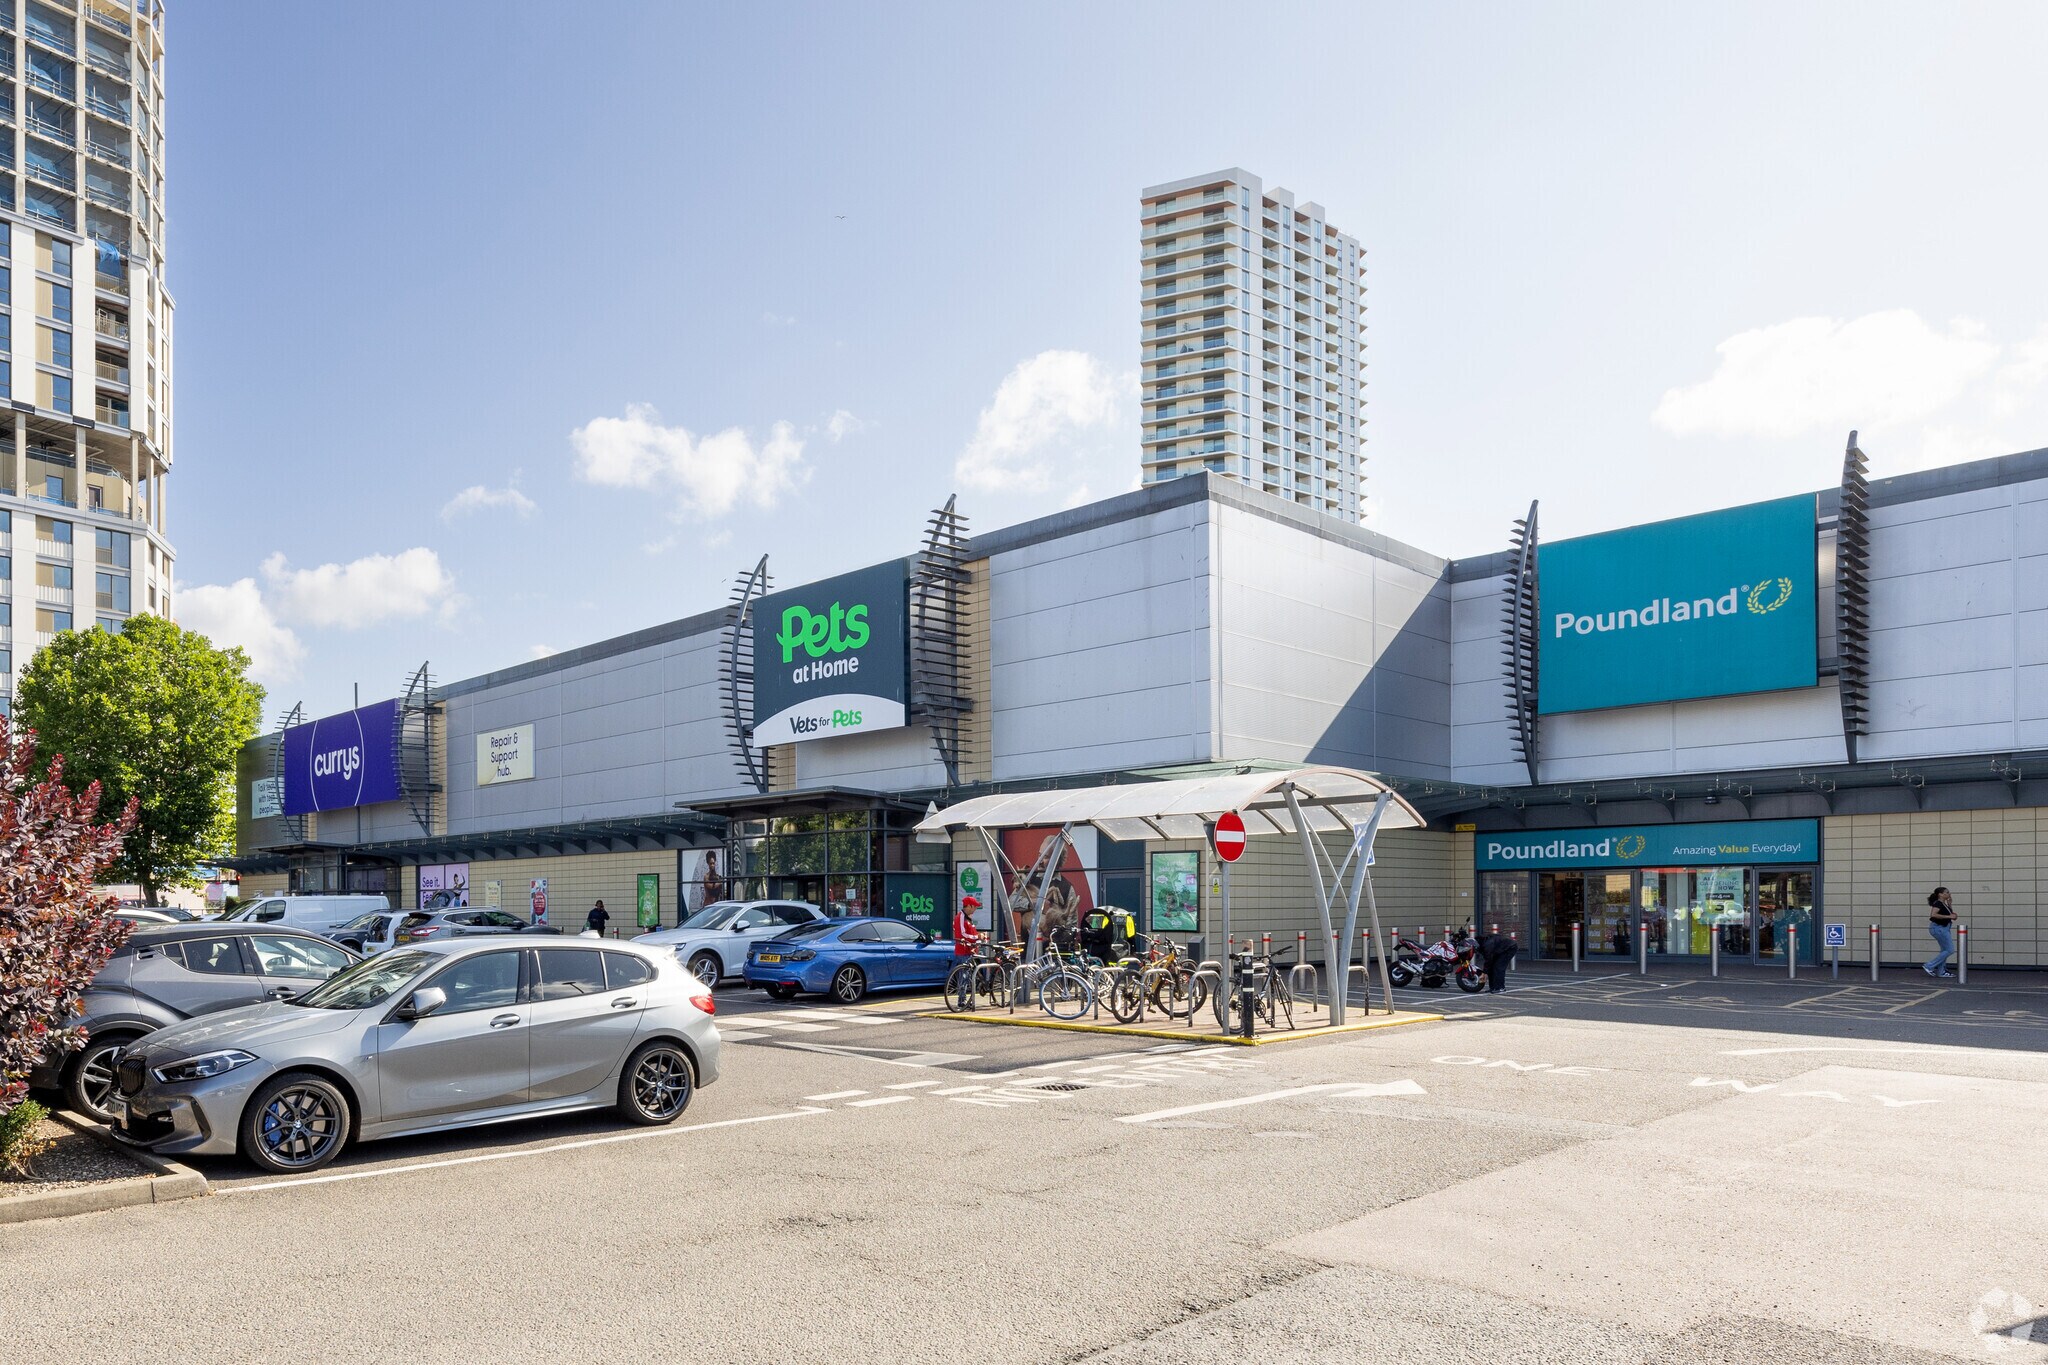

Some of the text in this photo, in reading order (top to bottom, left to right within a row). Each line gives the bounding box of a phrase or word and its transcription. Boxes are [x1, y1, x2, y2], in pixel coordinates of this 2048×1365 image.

[1554, 587, 1737, 638] Poundland
[776, 601, 870, 663] Pets
[792, 656, 859, 684] at Home
[789, 709, 862, 734] Vets for Pets
[490, 732, 518, 750] Repair &
[314, 745, 360, 781] currys
[490, 748, 518, 765] Support
[497, 764, 512, 777] hub.
[1488, 838, 1610, 860] Poundland
[1673, 842, 1801, 856] Amazing Value Everyday!
[422, 876, 433, 888] See
[900, 892, 934, 913] Pets
[1430, 1054, 1612, 1077] ONE
